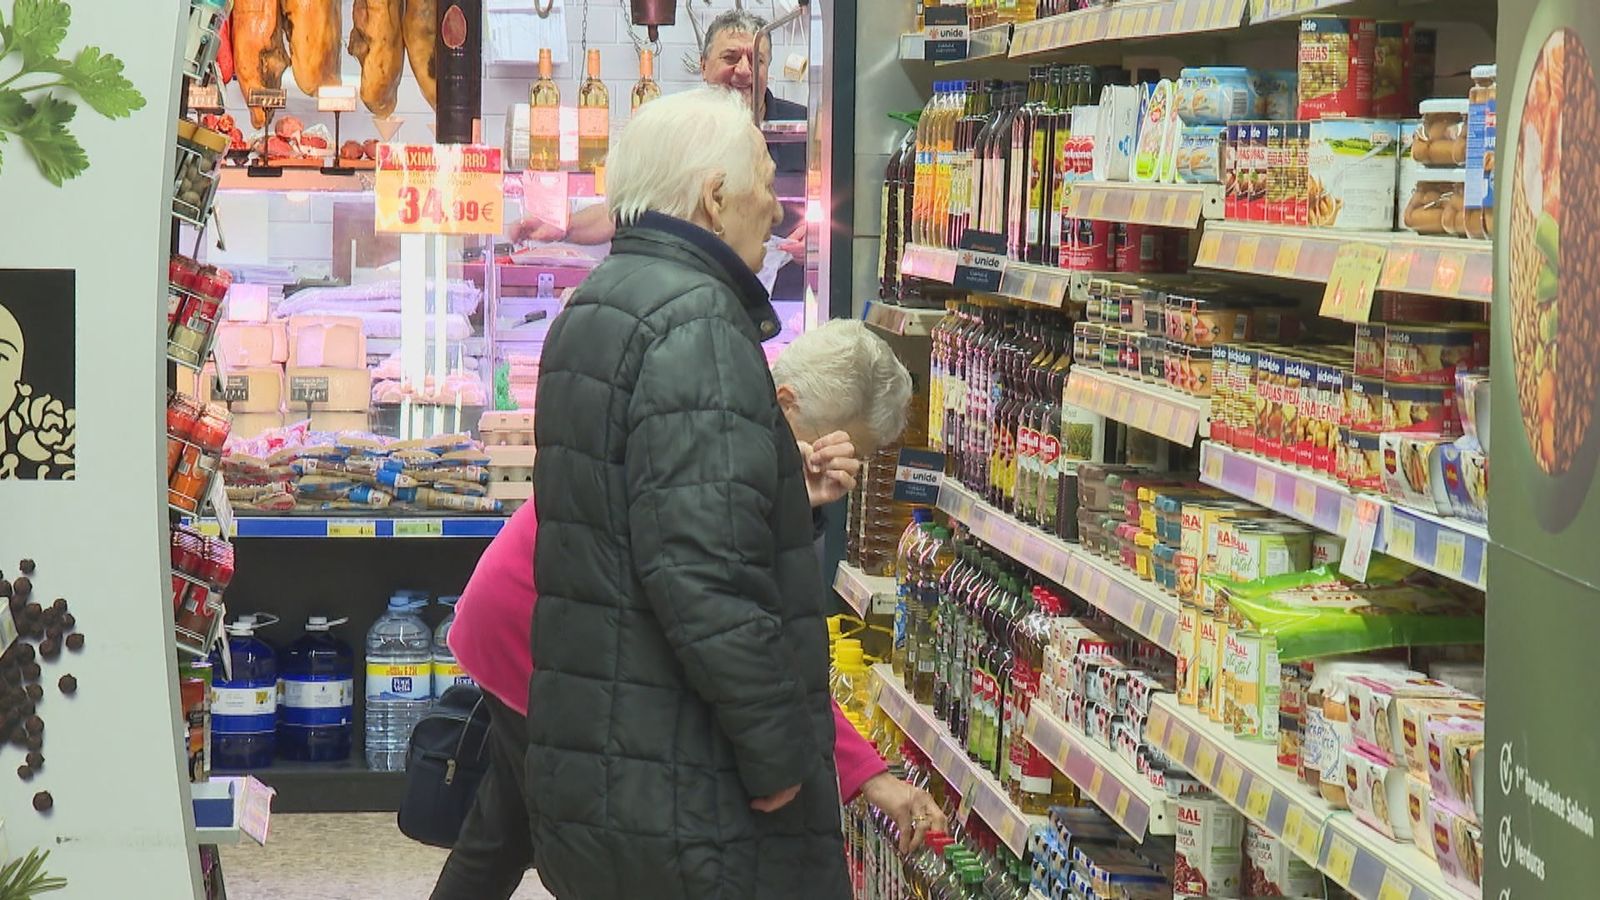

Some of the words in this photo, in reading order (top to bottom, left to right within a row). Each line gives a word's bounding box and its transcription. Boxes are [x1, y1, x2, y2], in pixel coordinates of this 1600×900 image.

[940, 28, 964, 38] unide
[974, 256, 1000, 268] unide
[912, 471, 938, 483] unide
